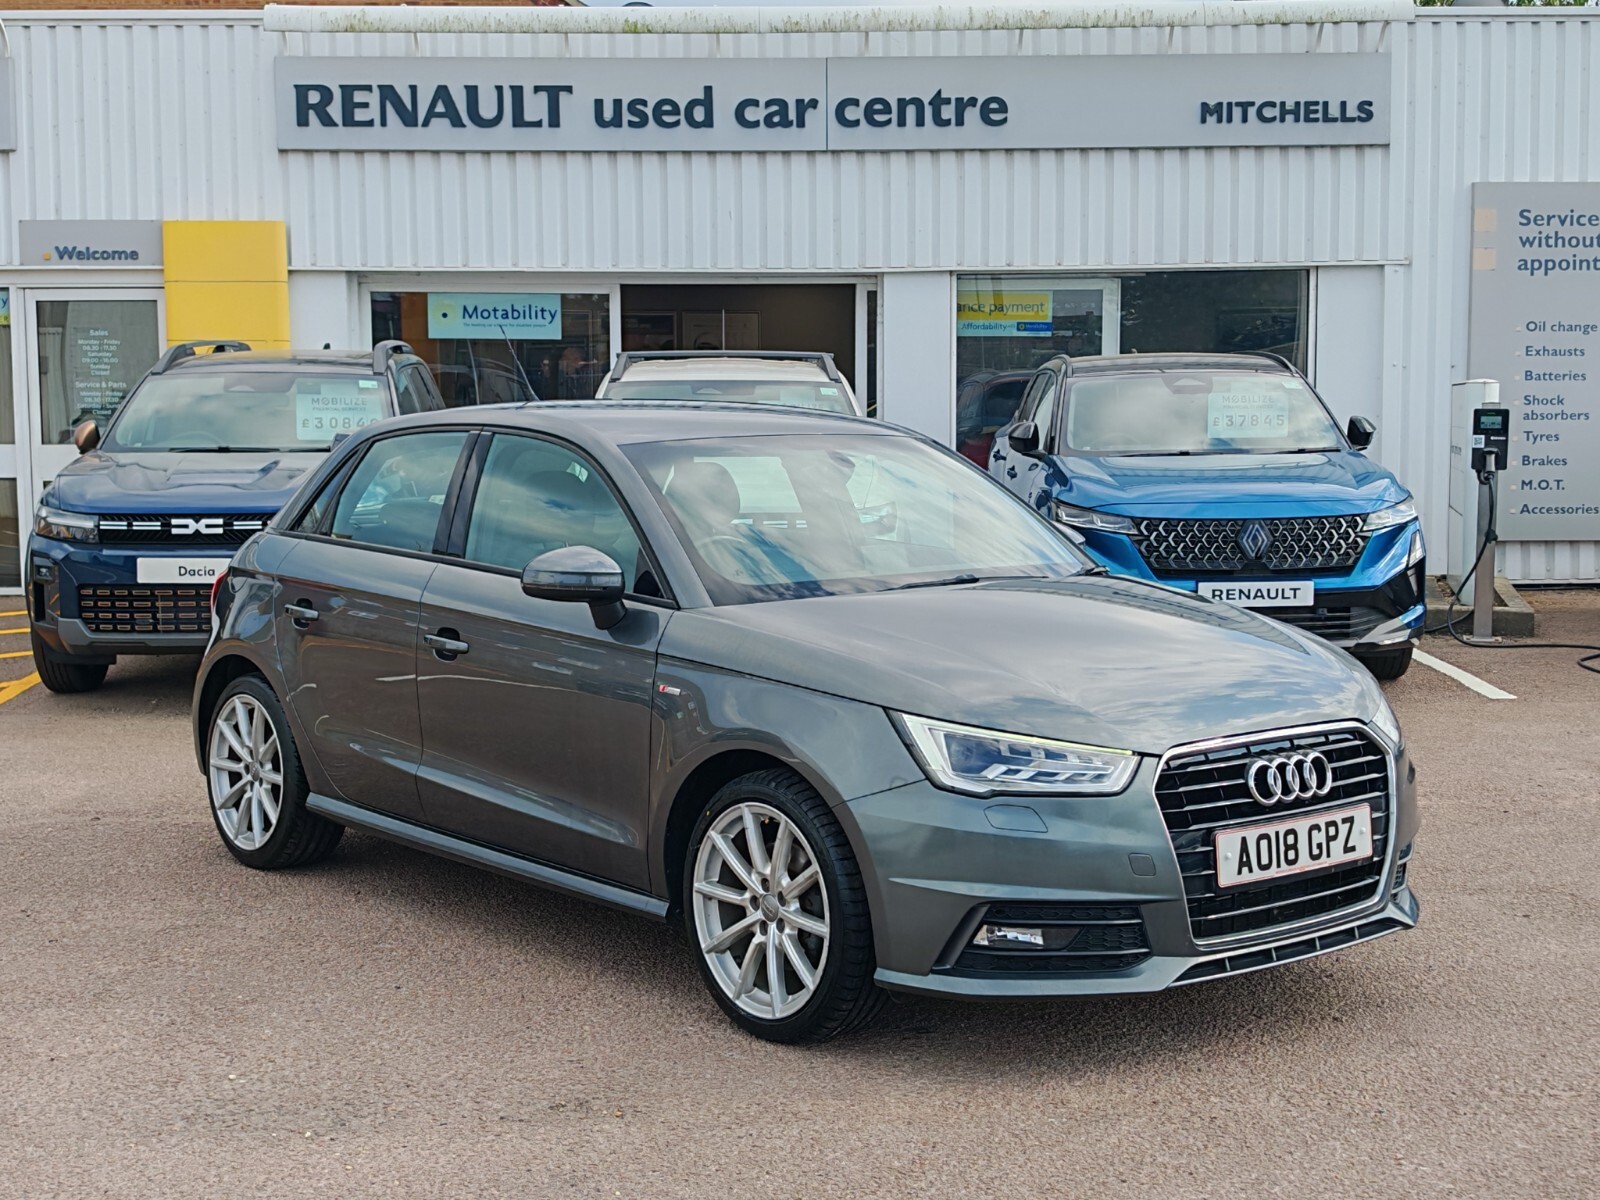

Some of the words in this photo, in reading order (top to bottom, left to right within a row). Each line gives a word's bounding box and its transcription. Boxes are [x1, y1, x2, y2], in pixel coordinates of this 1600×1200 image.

[293, 84, 574, 128] RENAULT
[594, 85, 714, 129] used
[734, 98, 819, 129] car
[834, 88, 1009, 128] centre
[1200, 100, 1375, 124] MITCHELLS
[1518, 208, 1600, 227] Service
[54, 246, 139, 261] Welcome
[462, 303, 558, 325] Motability
[988, 301, 1046, 317] payment
[89, 329, 109, 337] Sales
[961, 322, 1007, 332] Affordability
[1525, 320, 1546, 332] Oil
[1550, 320, 1598, 336] change
[1525, 345, 1586, 357] Exhausts
[1524, 370, 1587, 381] Batteries
[1523, 394, 1565, 406] Shock
[1522, 409, 1590, 421] absorbers
[1523, 430, 1560, 445] Tyres
[1521, 454, 1568, 466] Brakes
[1520, 479, 1565, 491] M.O.T.
[1519, 503, 1600, 515] Accessories
[178, 566, 216, 577] Dacia
[1211, 588, 1302, 600] RENAULT
[1236, 828, 1300, 876] AO18
[1307, 815, 1357, 862] GPZ
